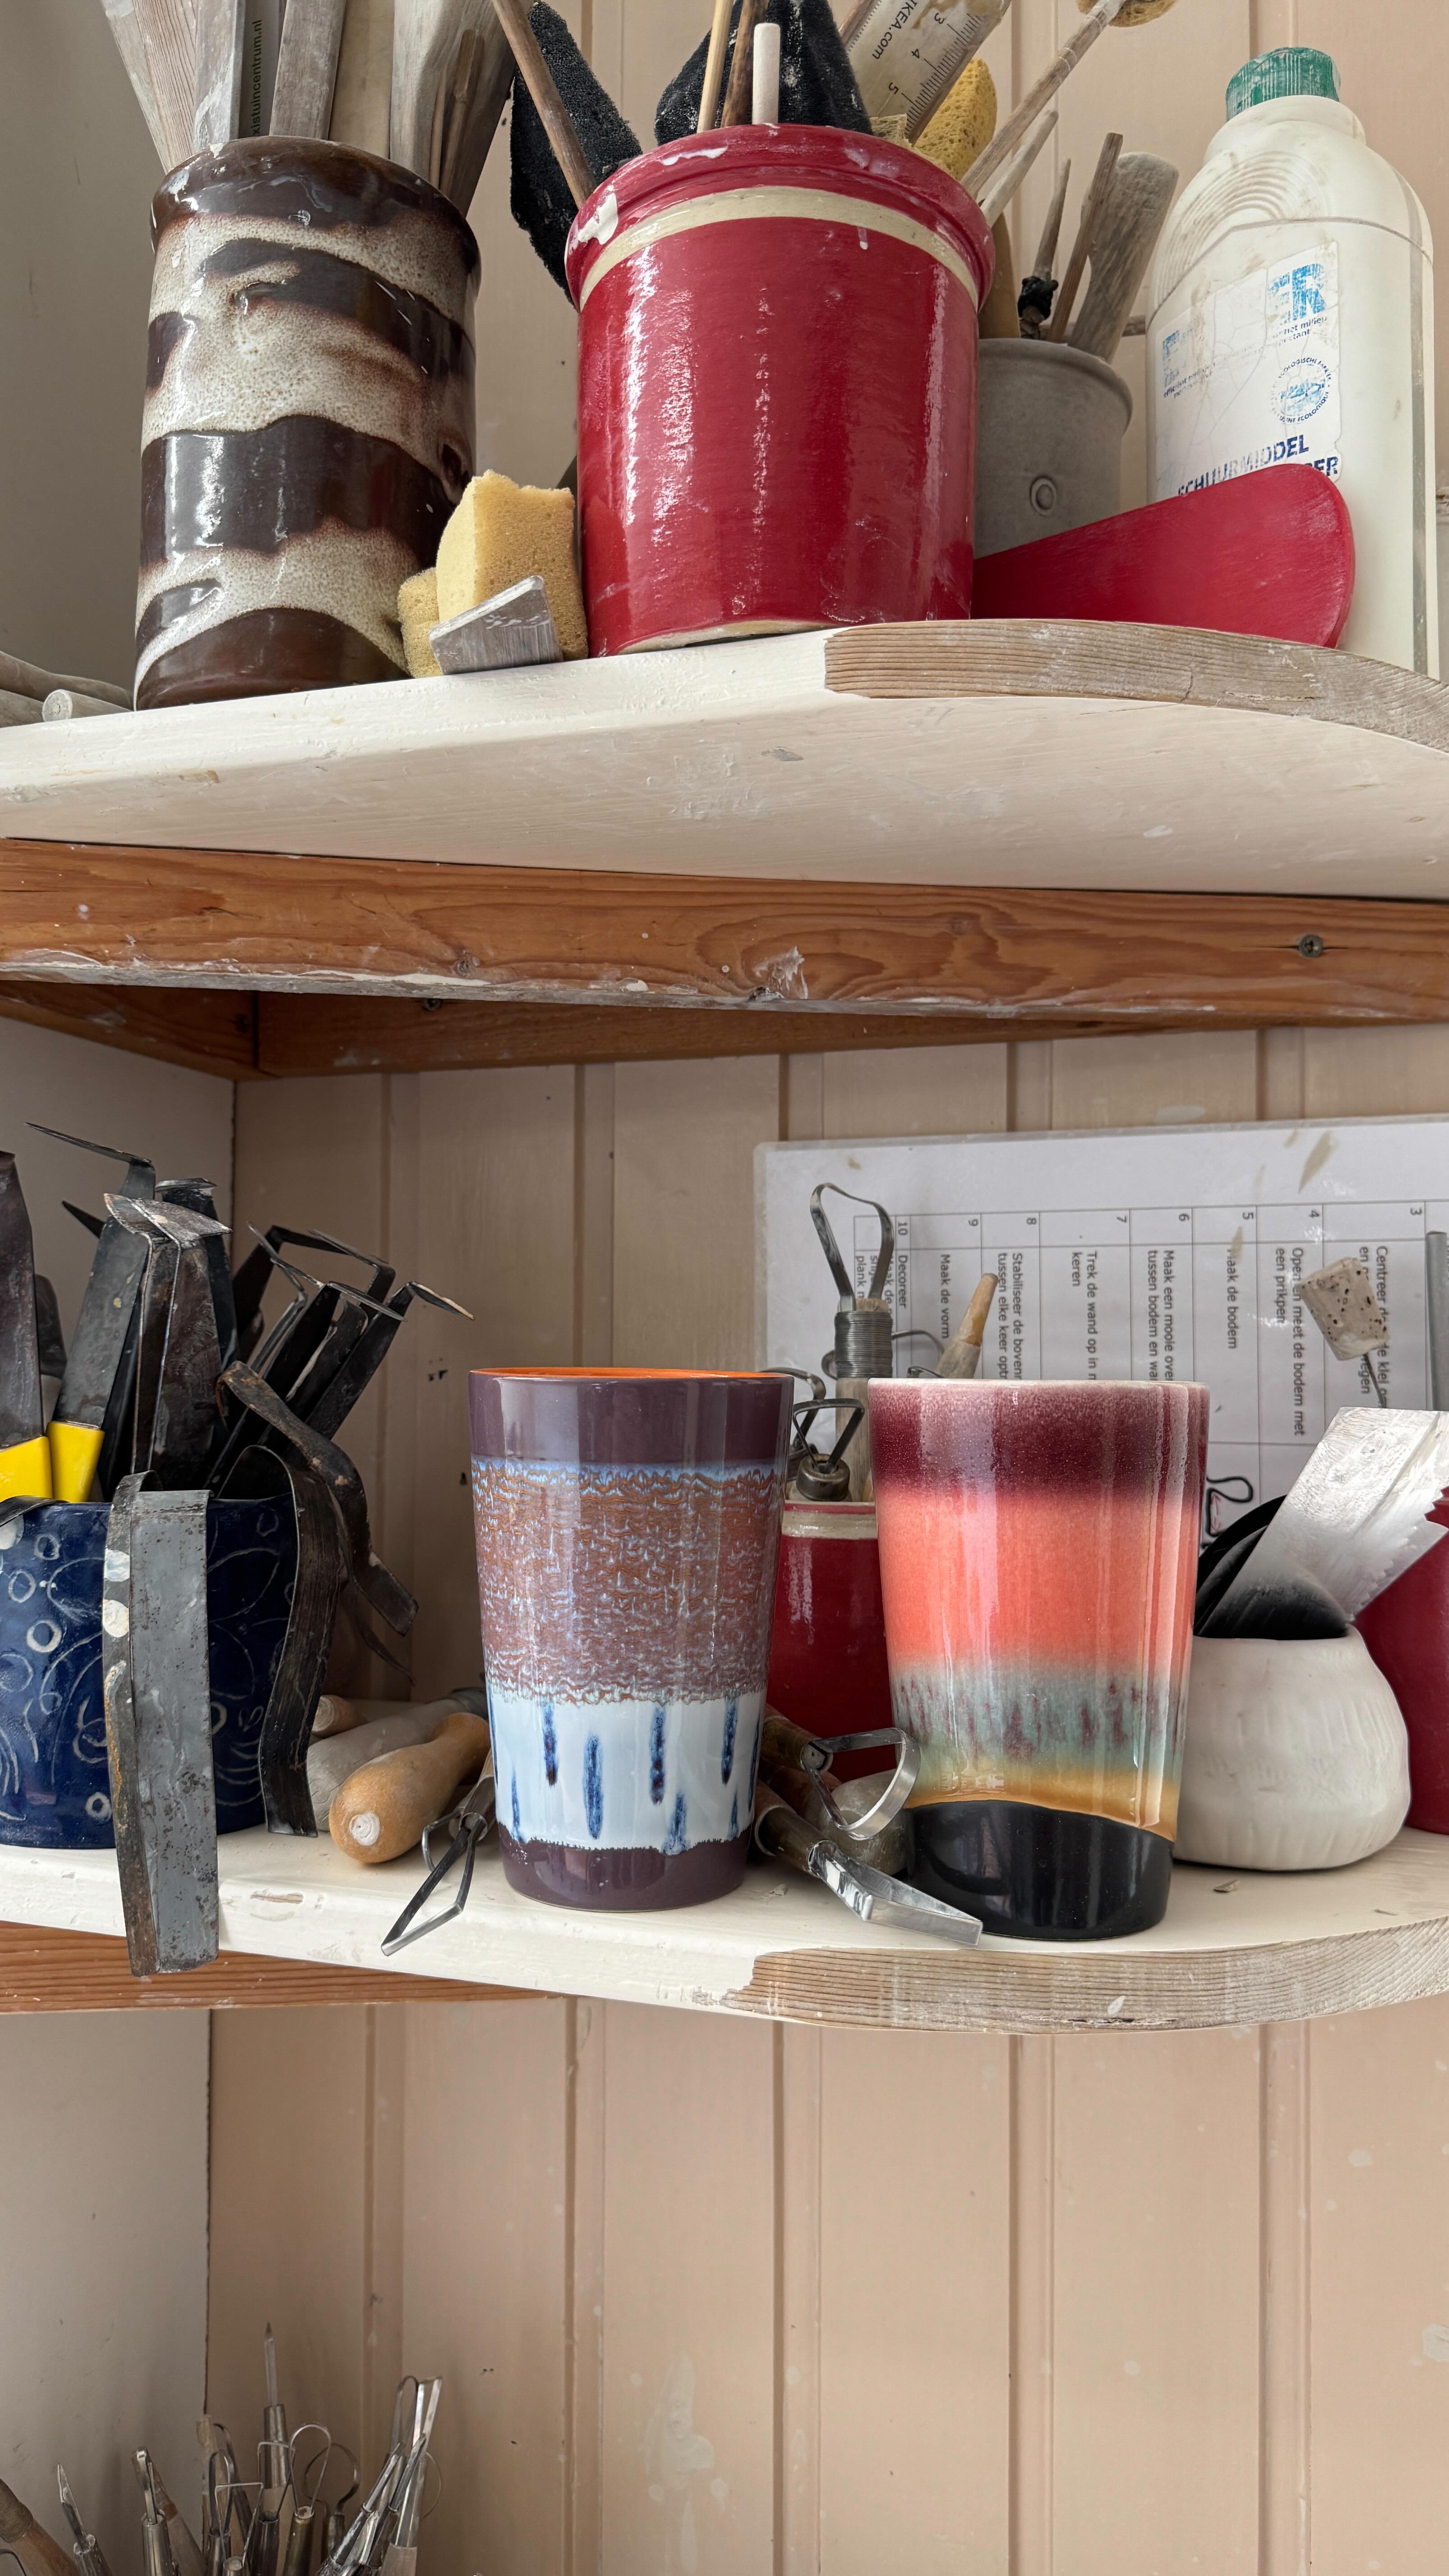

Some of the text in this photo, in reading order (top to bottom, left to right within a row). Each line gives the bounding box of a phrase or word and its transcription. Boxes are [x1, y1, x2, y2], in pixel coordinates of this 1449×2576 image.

[872, 0, 917, 59] IKEA.com
[934, 13, 945, 24] 3
[911, 49, 920, 59] 4
[888, 83, 899, 94] 5
[1117, 1215, 1127, 1223] 7
[1178, 1213, 1189, 1222] 6
[1242, 1212, 1254, 1220] 5
[1410, 1208, 1422, 1216] 3
[898, 1222, 908, 1236] 10
[1087, 1251, 1097, 1279] Trek
[1164, 1250, 1175, 1283] Maak
[1290, 1247, 1304, 1281] Open
[1359, 1246, 1369, 1262] en
[855, 1255, 867, 1287] plank
[898, 1255, 908, 1308] Decoreer
[998, 1253, 1007, 1293] tussen
[1072, 1251, 1082, 1287] keren
[1148, 1250, 1158, 1291] tussen
[1376, 1246, 1388, 1303] Centreer
[940, 1254, 952, 1339] Maak de vorm
[1013, 1253, 1024, 1316] Stabiliseer
[1087, 1283, 1098, 1298] de
[1227, 1286, 1238, 1302] de
[1274, 1248, 1287, 1323] een prikpen
[998, 1297, 1009, 1321] elke
[1164, 1287, 1173, 1310] een
[1013, 1320, 1024, 1334] de
[1088, 1302, 1098, 1335] wand
[1149, 1295, 1159, 1338] bodem
[1227, 1306, 1239, 1349] bodem
[1293, 1306, 1303, 1339] meet
[999, 1324, 1010, 1352] keer
[1085, 1338, 1096, 1353] op
[1164, 1314, 1176, 1352] mooie
[1149, 1341, 1158, 1356] en
[1293, 1342, 1305, 1358] de
[1088, 1358, 1098, 1369] in
[1377, 1361, 1389, 1385] klei
[1293, 1362, 1306, 1406] bodem
[1294, 1411, 1306, 1435] met
